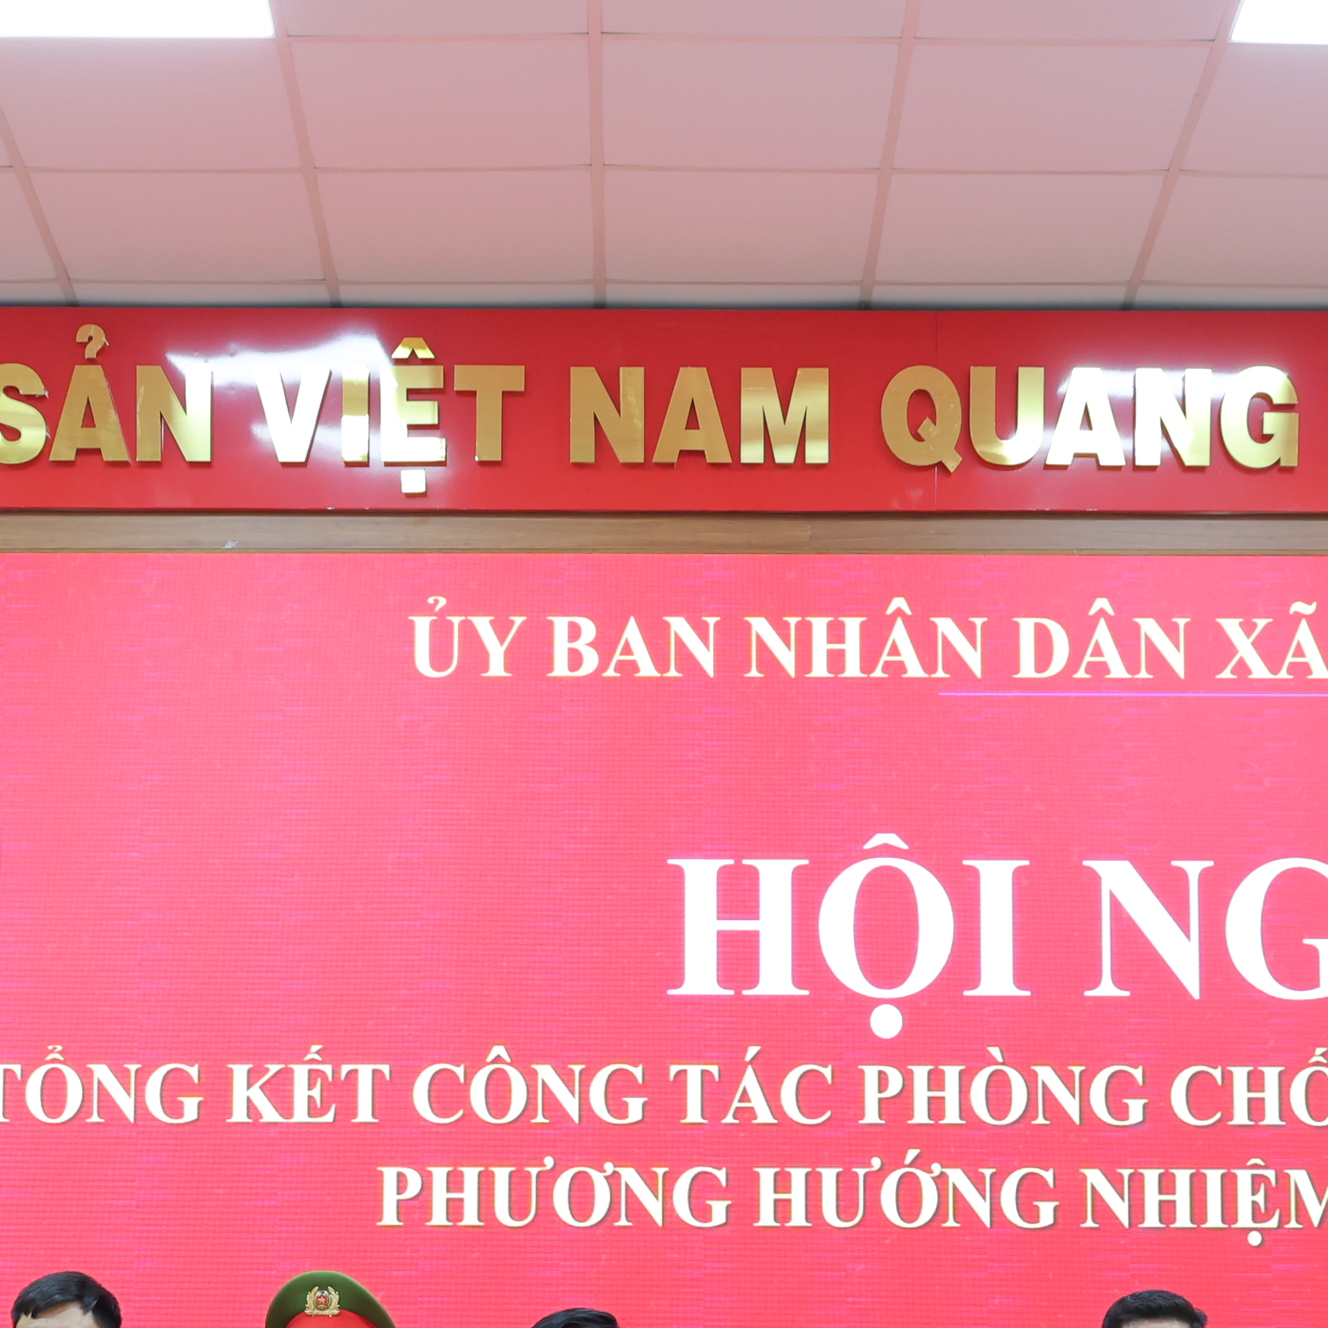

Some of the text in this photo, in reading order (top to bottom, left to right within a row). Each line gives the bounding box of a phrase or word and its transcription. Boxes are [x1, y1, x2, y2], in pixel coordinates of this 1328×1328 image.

[254, 336, 525, 495] VIỆT
[568, 365, 830, 465] NAM
[880, 363, 1300, 475] QUANG
[409, 597, 526, 678] ỦY
[547, 617, 720, 678] BAN
[744, 597, 987, 679] NHÂN
[1013, 597, 1190, 679] DÂN
[666, 832, 1032, 1039] HỘI
[226, 1044, 391, 1123] KẾT
[412, 1045, 649, 1125] CÔNG
[670, 1045, 832, 1125] TÁC
[858, 1046, 1148, 1126] PHÒNG
[376, 1156, 732, 1228] PHƯƠNG
[753, 1149, 1060, 1229] HƯỚNG
